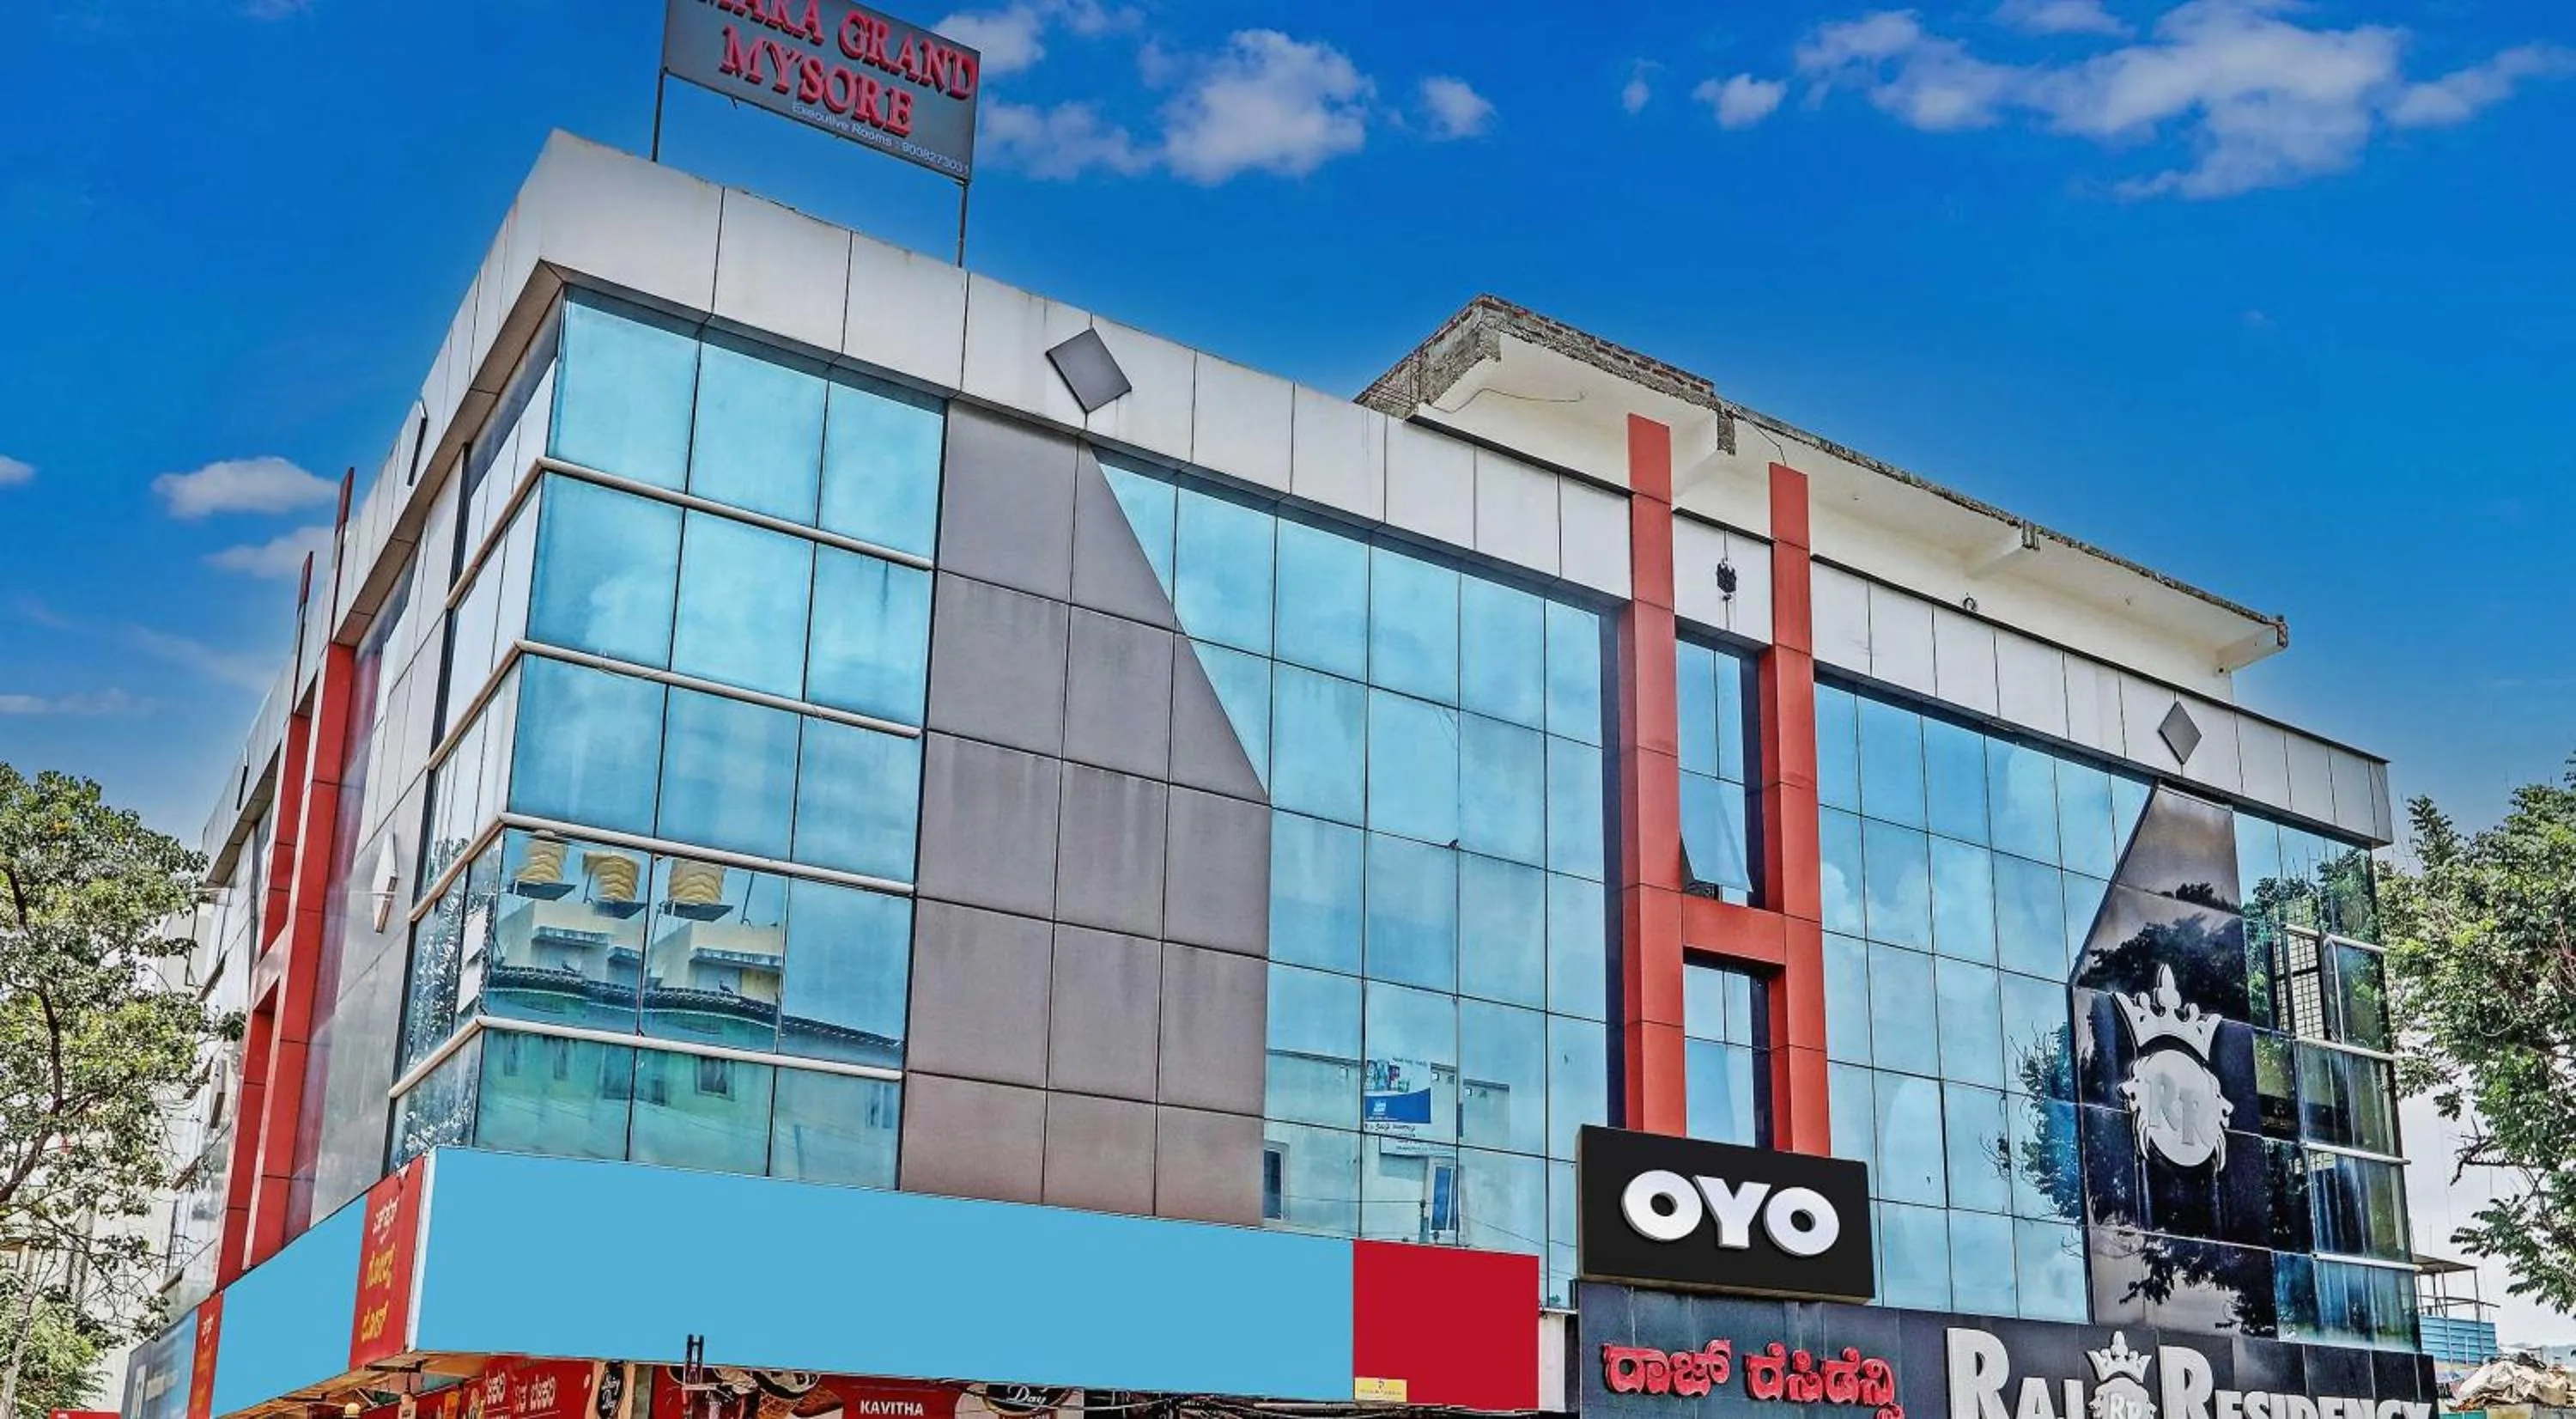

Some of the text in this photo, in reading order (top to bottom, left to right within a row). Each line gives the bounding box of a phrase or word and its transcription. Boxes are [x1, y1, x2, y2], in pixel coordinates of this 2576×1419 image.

[719, 23, 913, 137] MYSORE
[838, 9, 978, 100] GRAND
[792, 100, 849, 131] Executive
[851, 123, 893, 147] Rooms
[1621, 1169, 1840, 1256] OYO
[1006, 1383, 1047, 1413] Day
[1602, 1337, 1732, 1397] ರಾಜ್
[1947, 1327, 2433, 1419] RAJ RESIDEN
[860, 1398, 925, 1416] KAVITHA
